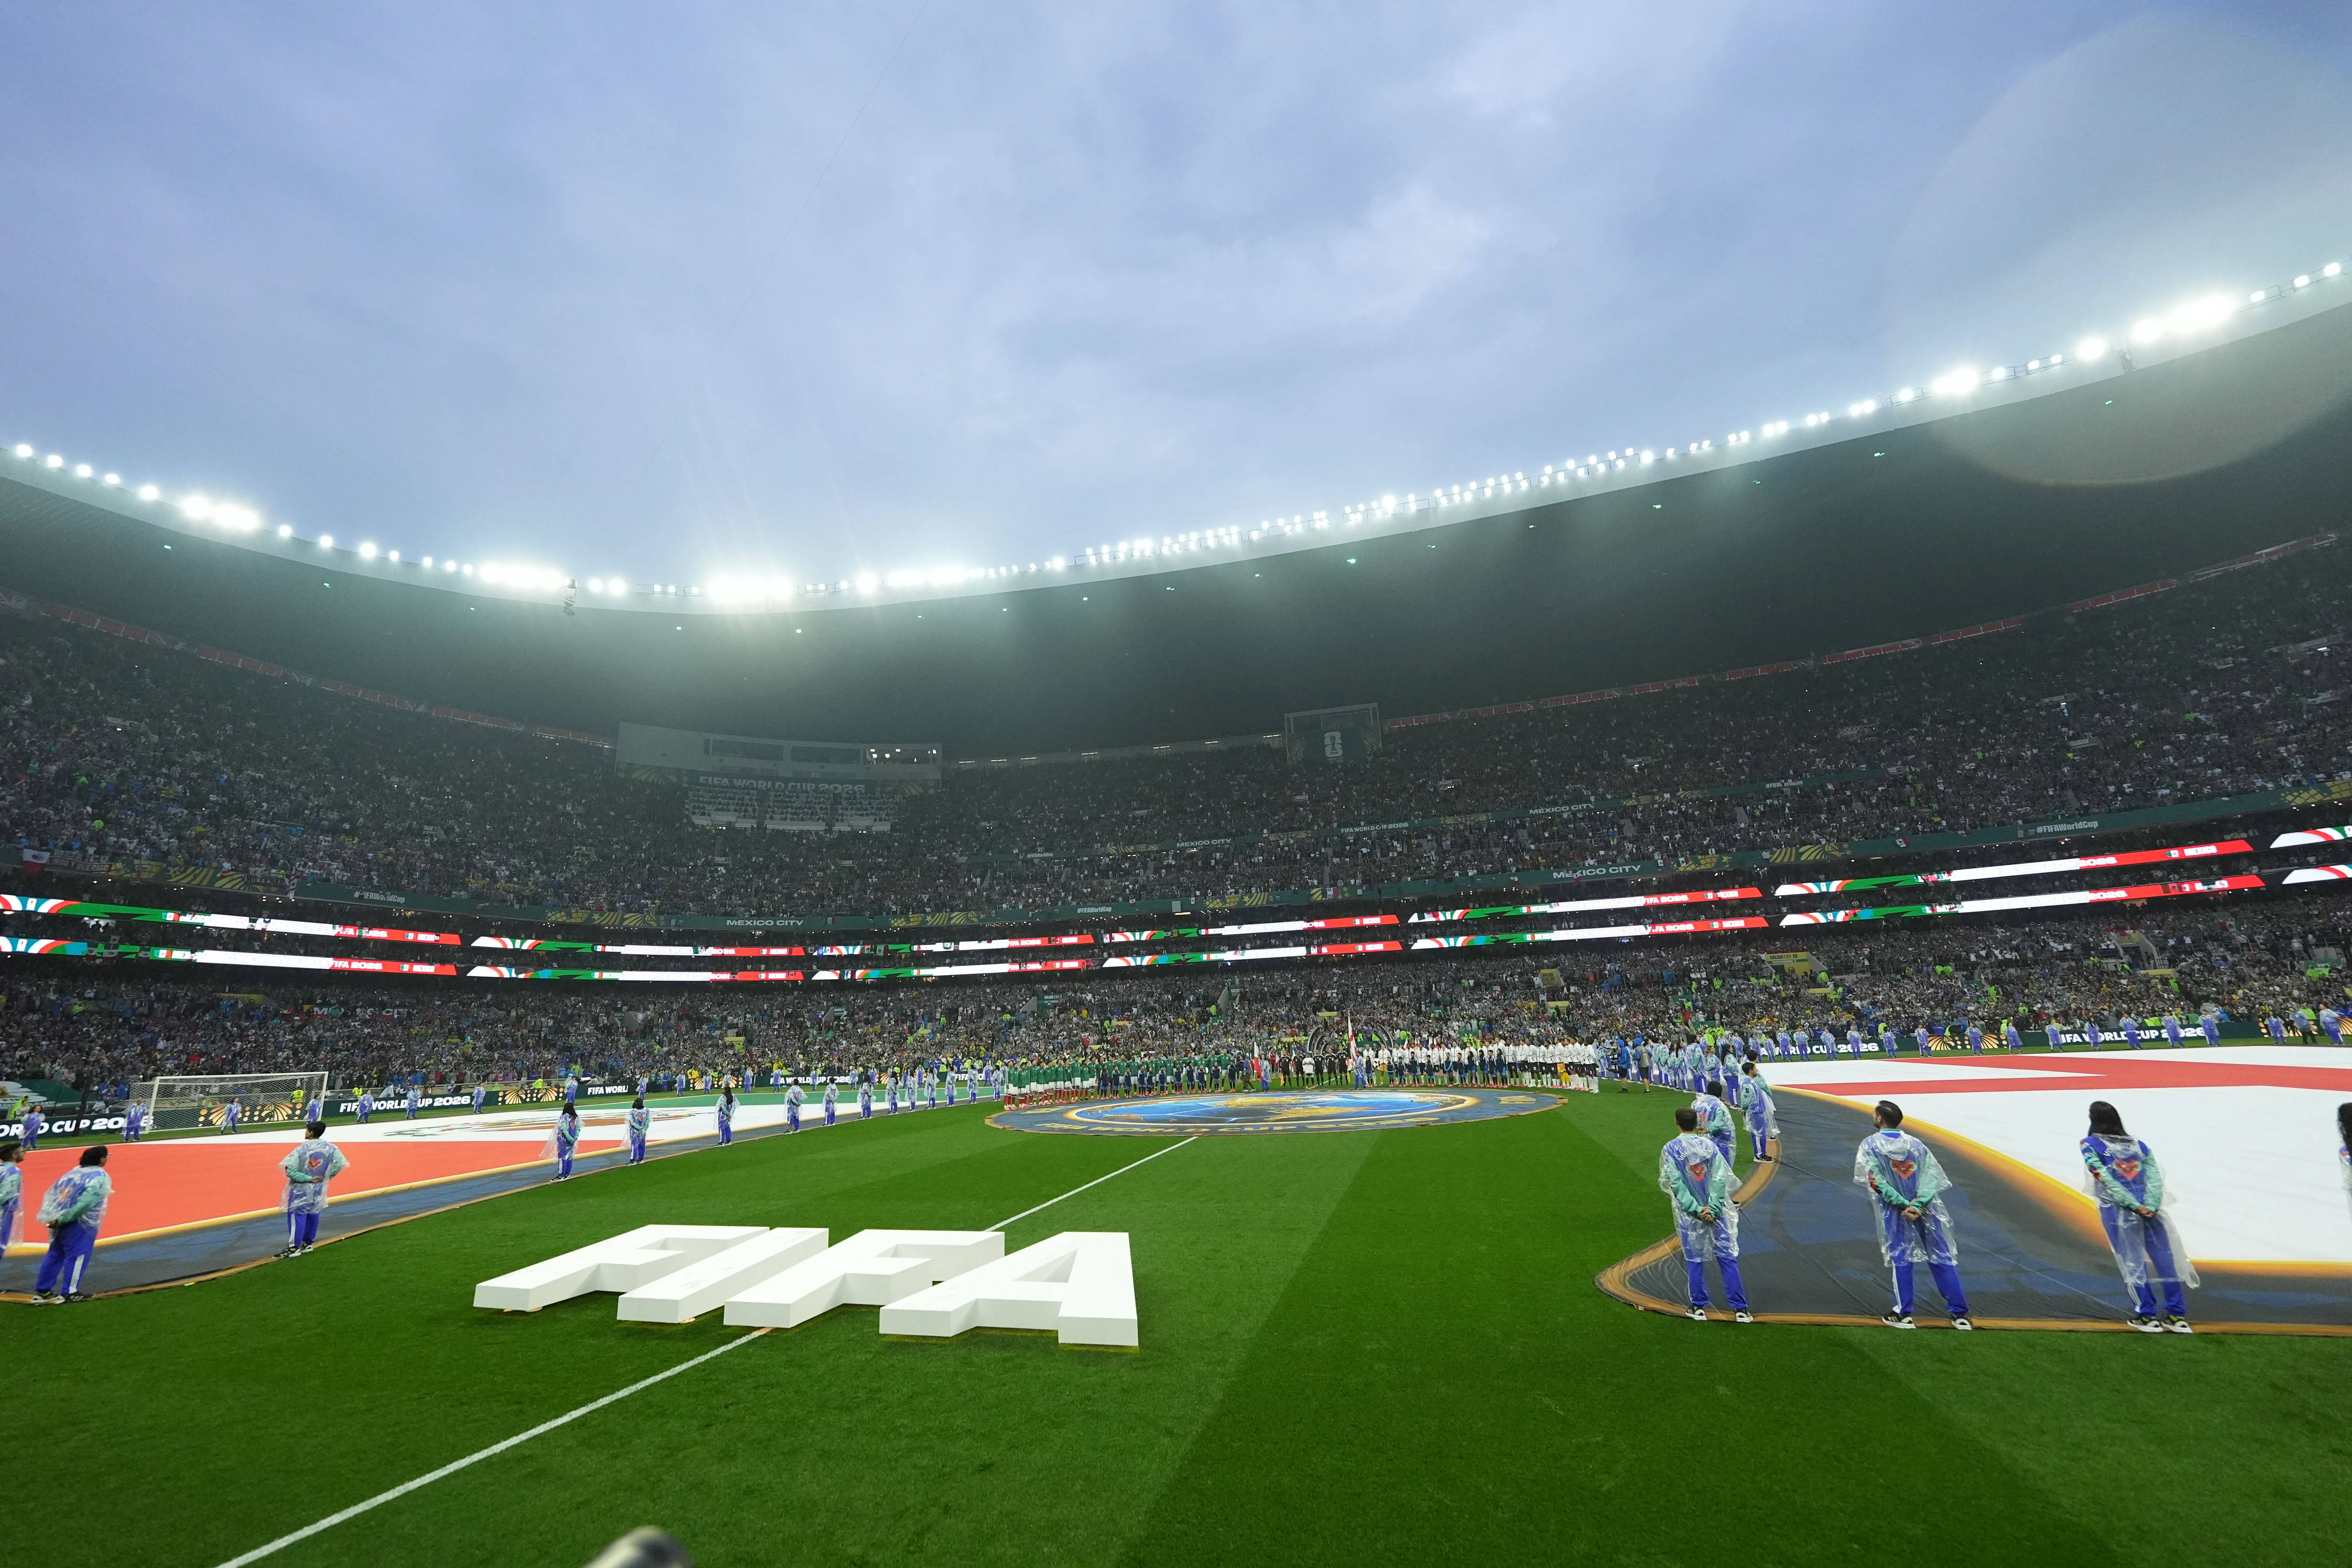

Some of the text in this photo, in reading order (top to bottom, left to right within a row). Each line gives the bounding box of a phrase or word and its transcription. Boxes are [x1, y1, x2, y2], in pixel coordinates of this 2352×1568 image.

[700, 776, 730, 786] FIFA
[818, 784, 866, 794] 2026
[1530, 806, 1569, 814] MEXICO
[2036, 821, 2098, 833] #FIFAWorldCup
[2184, 846, 2217, 856] MEXICO
[2079, 857, 2117, 867] 2026
[1609, 865, 1641, 873] CITY
[2089, 890, 2127, 900] 2026
[2062, 1033, 2079, 1044] IFA
[2136, 1029, 2159, 1040] CUP
[588, 1087, 604, 1095] FIFA
[339, 1102, 360, 1112] FIF
[417, 1098, 432, 1107] UP
[433, 1096, 471, 1106] 2026
[92, 1116, 154, 1130] 206
[473, 1224, 1139, 1345] FIFA
